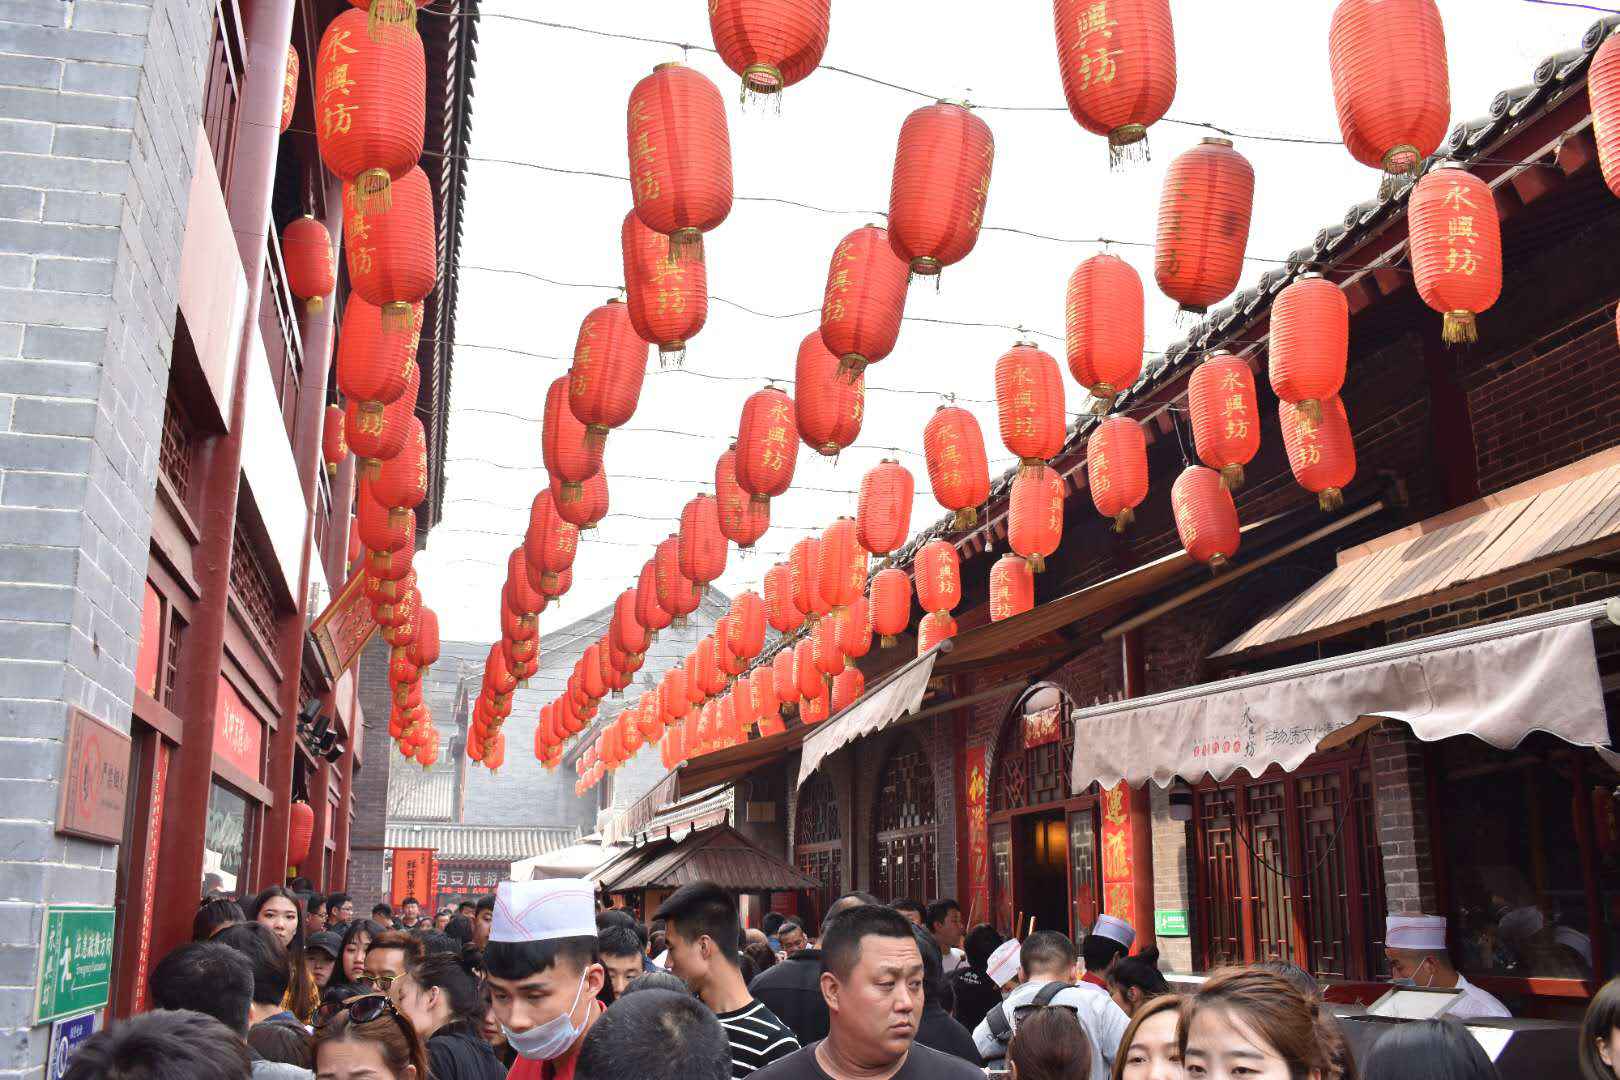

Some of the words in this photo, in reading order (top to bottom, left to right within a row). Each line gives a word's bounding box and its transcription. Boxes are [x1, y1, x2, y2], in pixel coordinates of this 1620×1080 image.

[321, 28, 361, 140] 永興坊
[1440, 180, 1485, 276] 永興坊
[762, 400, 794, 472] 永興坊
[1012, 363, 1038, 438] 永興坊
[1220, 368, 1251, 440] 永興坊
[937, 551, 955, 594] 永興坊
